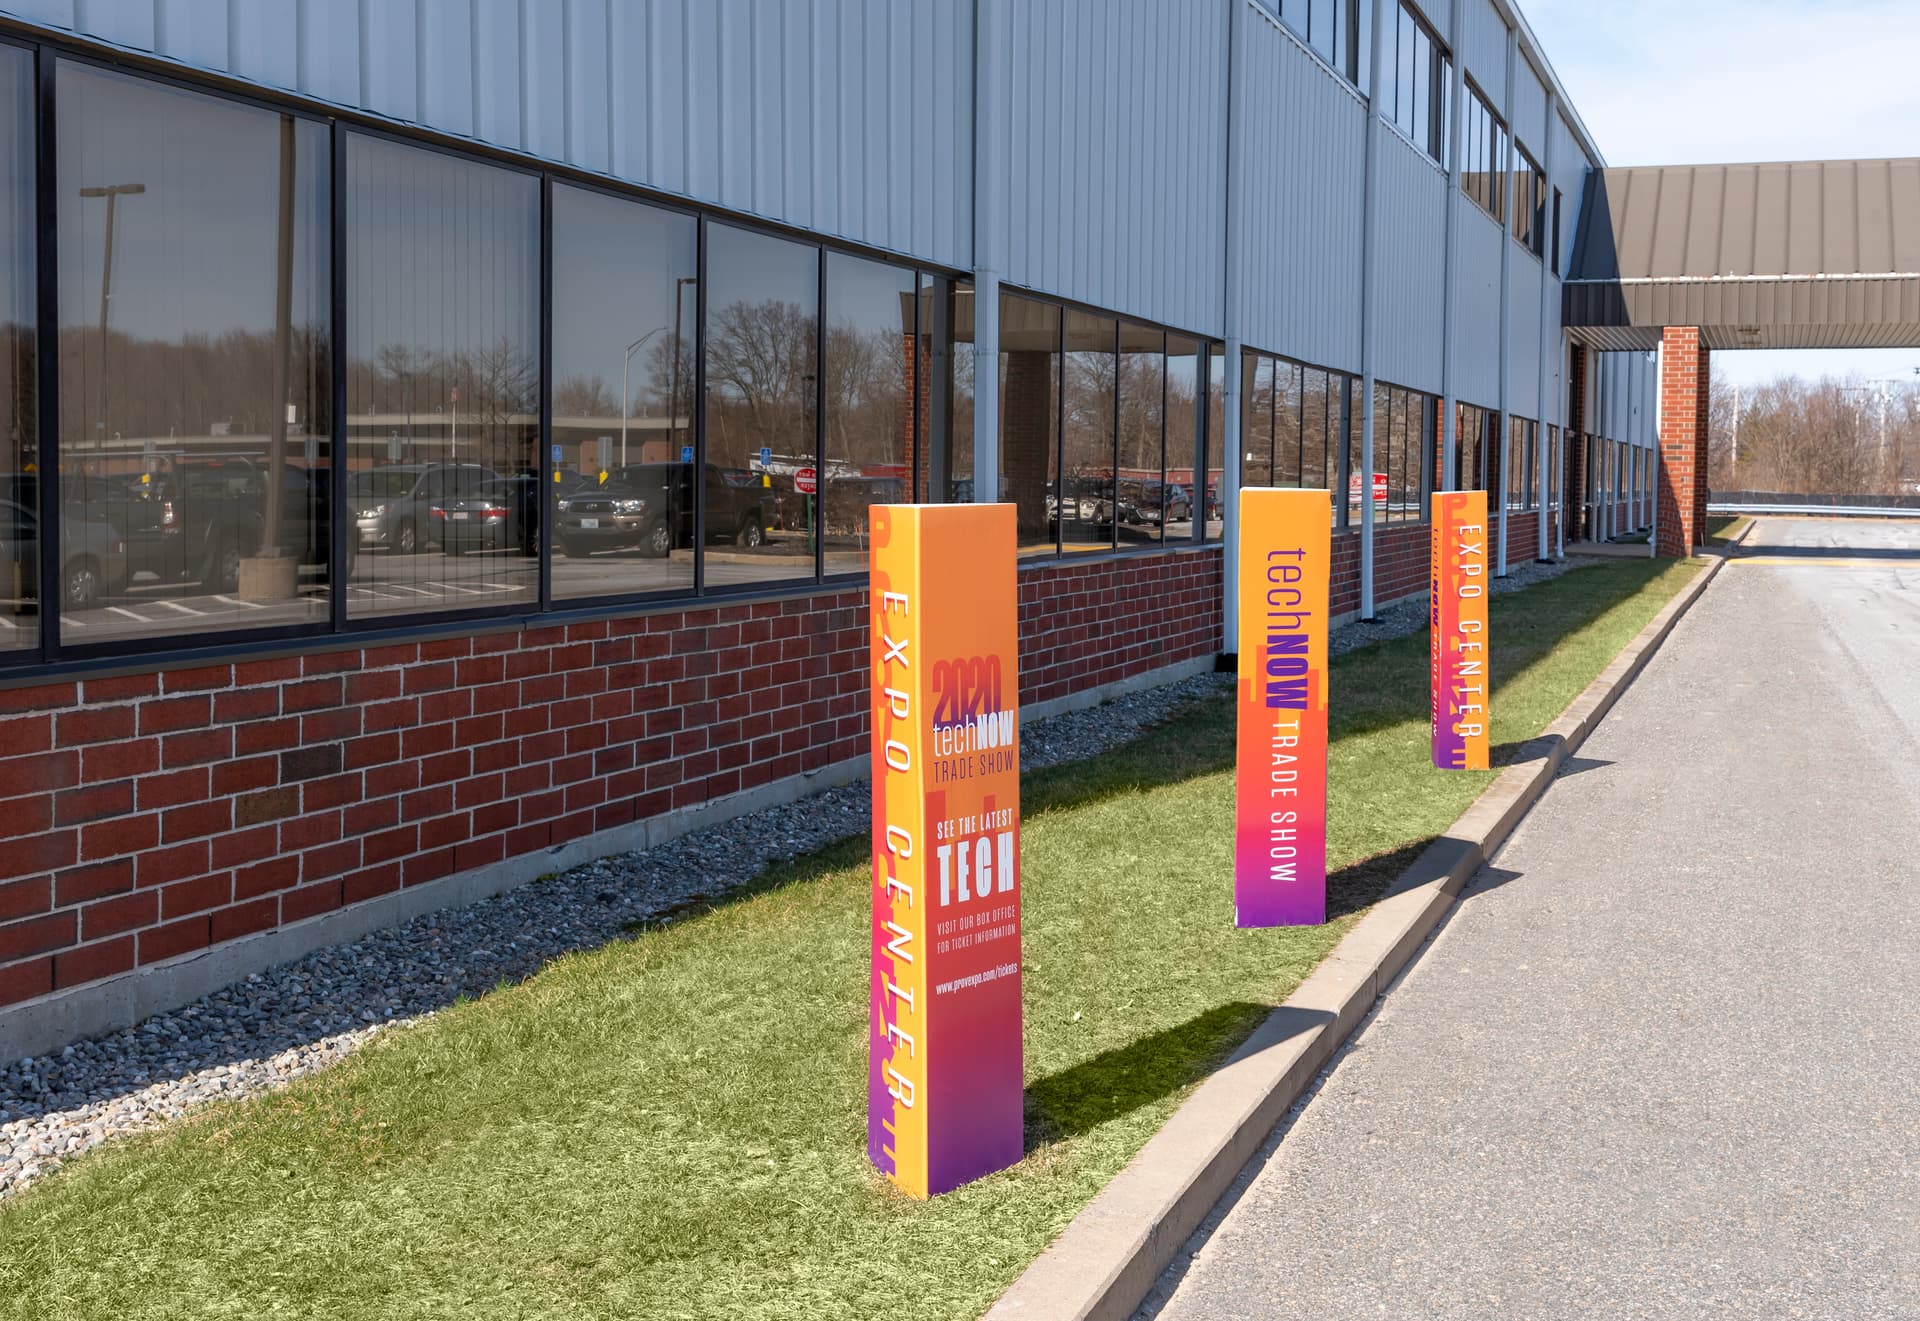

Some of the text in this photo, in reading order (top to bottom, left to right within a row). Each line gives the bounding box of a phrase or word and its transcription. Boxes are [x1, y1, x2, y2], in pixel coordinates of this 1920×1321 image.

[1458, 524, 1483, 737] EXPO CENTER
[882, 590, 912, 772] EXPO
[932, 654, 1001, 733] 2020
[1265, 547, 1312, 882] techNOW TRADE SHOW
[933, 710, 1014, 758] techNOW
[934, 750, 1014, 784] TRADE SHOW
[937, 808, 1013, 840] SEE THE LATEST
[936, 831, 1015, 907] TECH
[937, 904, 1015, 936] VISIT OUR BOX OFFICE
[937, 923, 1016, 955] FOR TICKET INFORMATION
[885, 824, 915, 1110] CENTER
